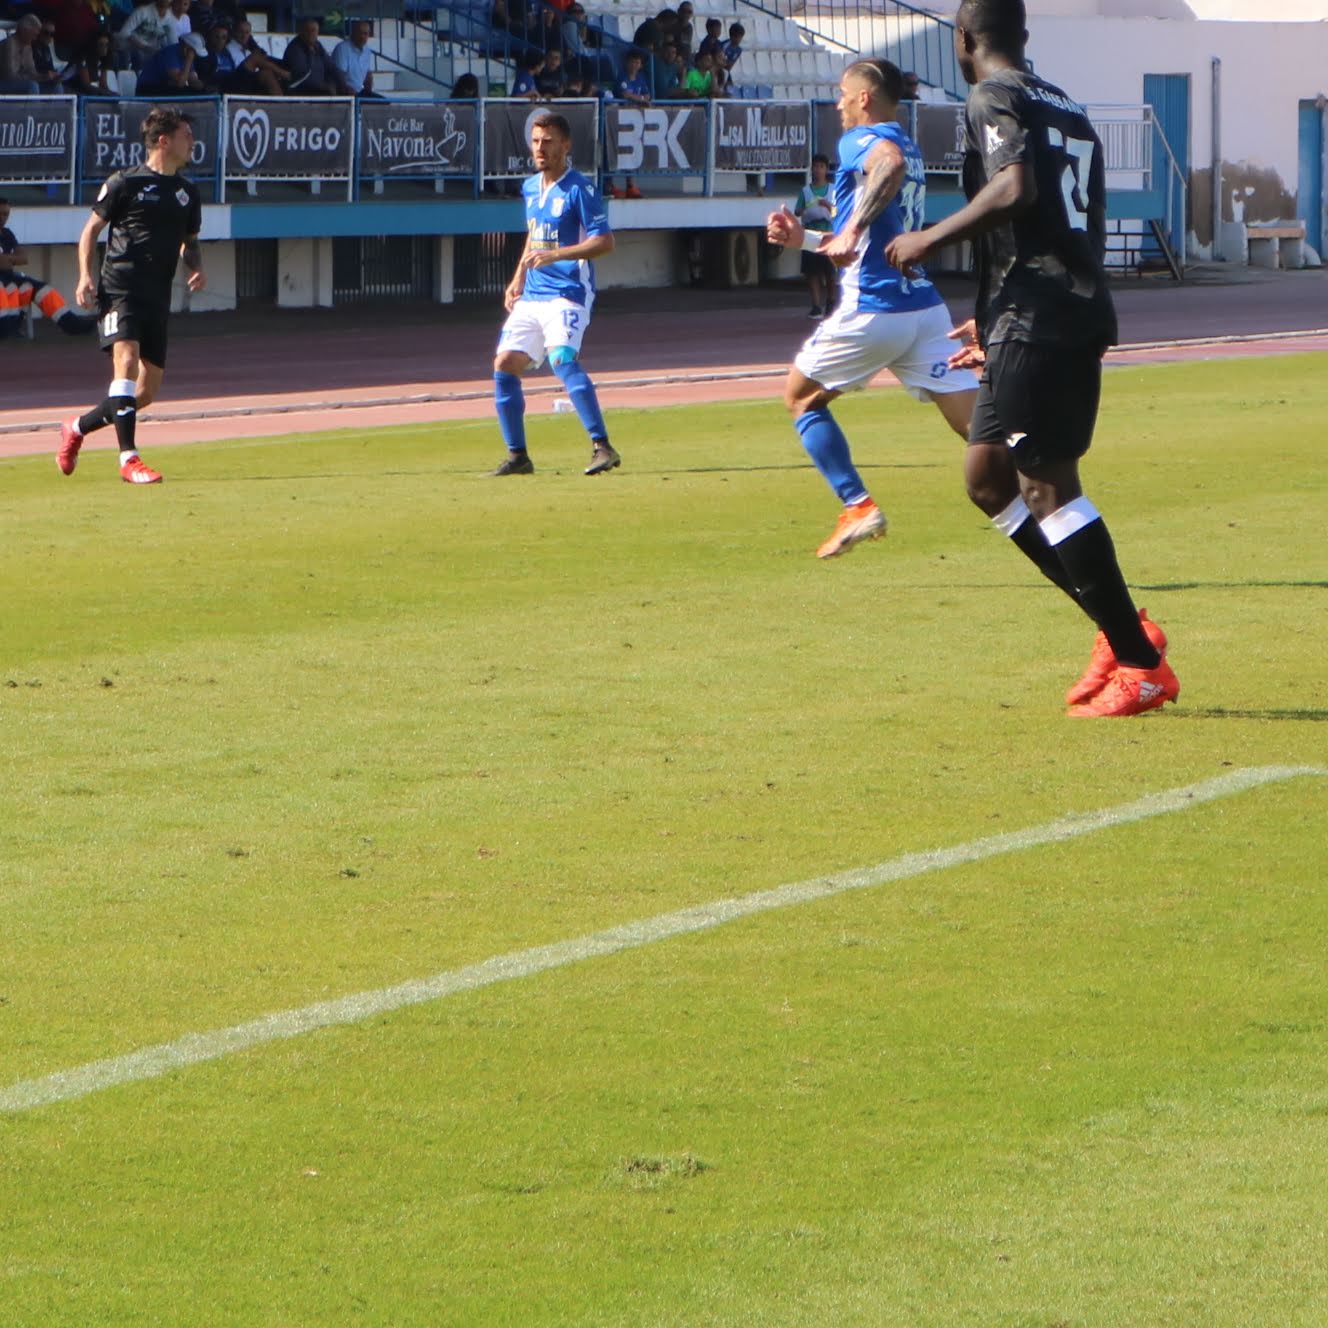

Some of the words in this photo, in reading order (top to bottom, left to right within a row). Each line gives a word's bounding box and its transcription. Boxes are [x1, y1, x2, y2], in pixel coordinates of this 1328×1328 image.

[96, 113, 126, 139] EL
[388, 117, 409, 132] Café
[410, 118, 425, 132] Bar
[274, 126, 341, 151] FRIGO
[367, 128, 435, 160] Navona
[562, 309, 579, 330] 12
